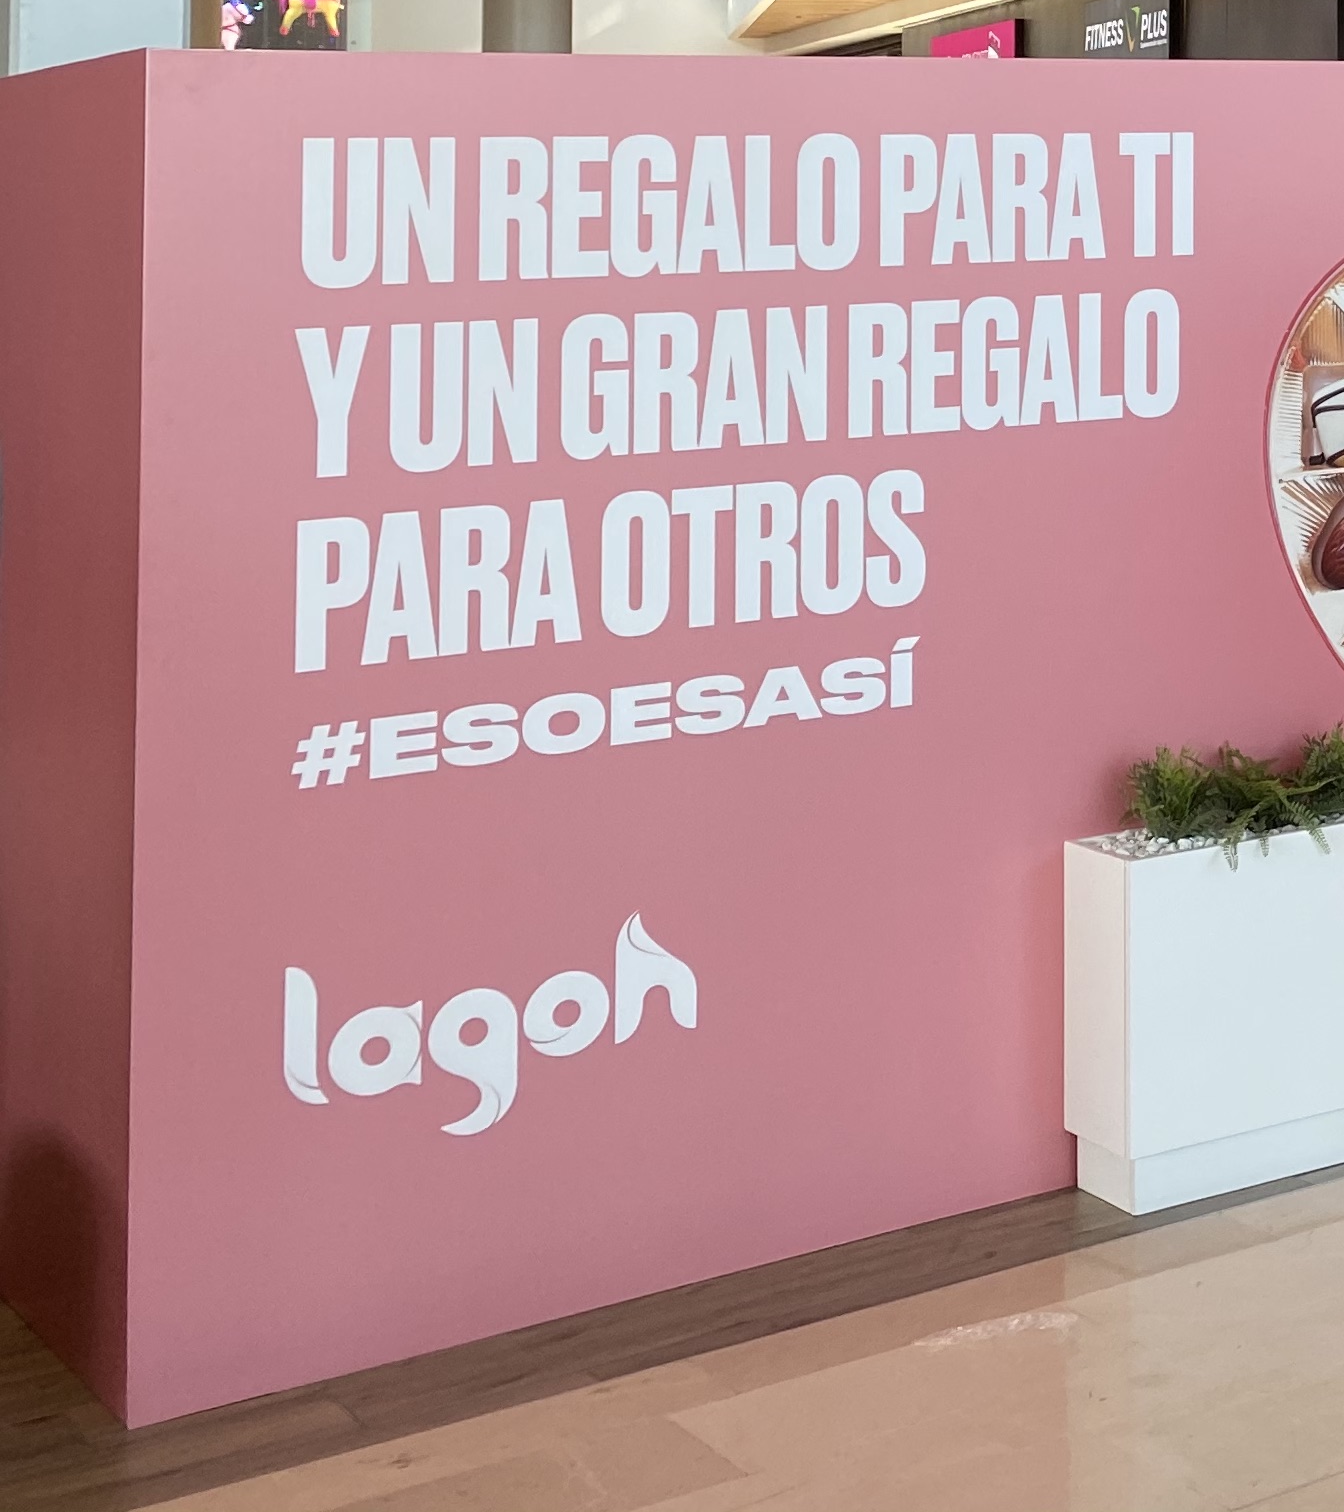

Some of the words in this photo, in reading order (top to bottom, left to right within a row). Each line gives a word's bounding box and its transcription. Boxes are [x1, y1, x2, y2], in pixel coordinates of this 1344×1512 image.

[1085, 18, 1124, 51] FITNESS
[1140, 9, 1167, 41] PLUS
[301, 136, 456, 289] UN
[478, 132, 861, 281] REGALO
[879, 132, 1106, 268] PARA
[1119, 131, 1195, 258] TI
[294, 325, 371, 479] Y
[389, 317, 540, 473] UN
[560, 304, 829, 461] GRAN
[847, 288, 1182, 439] REGALO
[294, 498, 582, 673] PARA
[600, 469, 926, 638] OTROS
[290, 635, 921, 789] #ESOESASÍ
[283, 909, 698, 1136] lagoh
